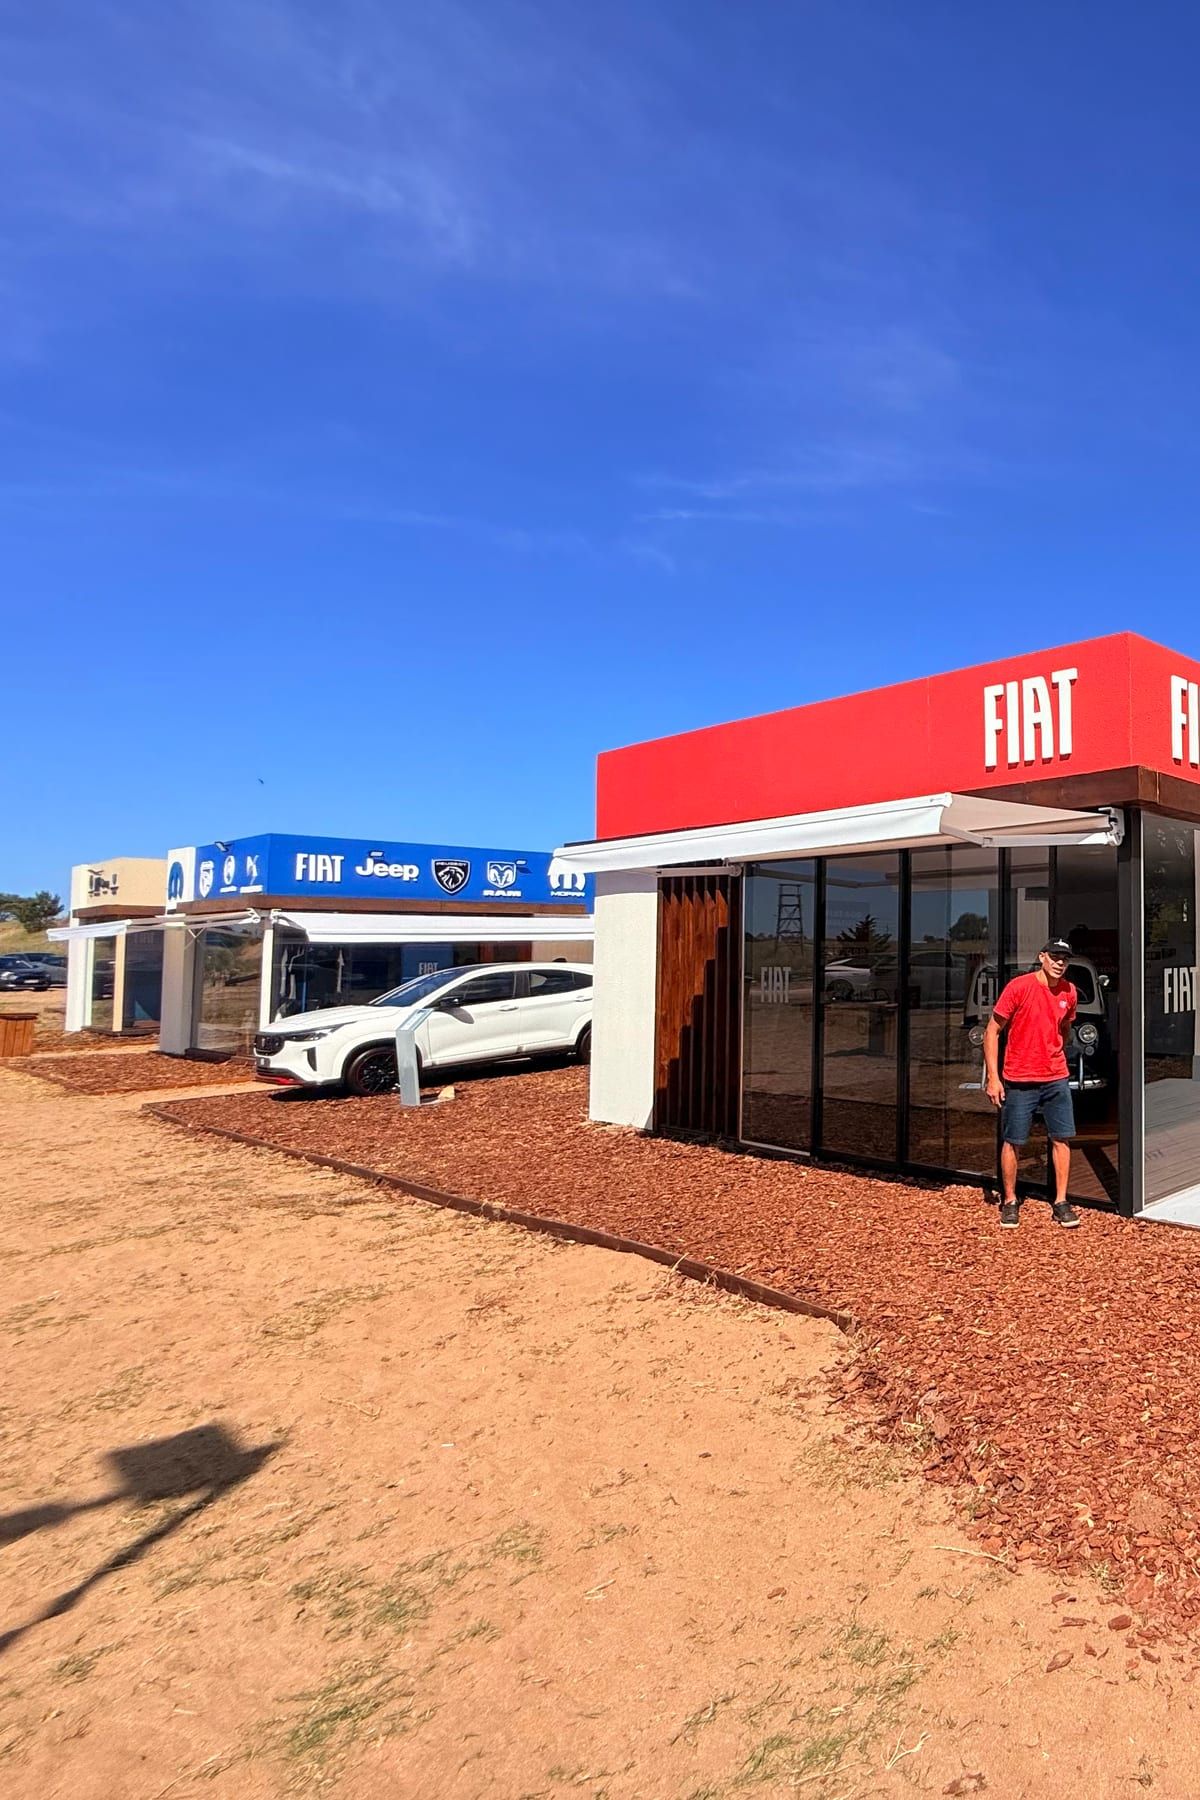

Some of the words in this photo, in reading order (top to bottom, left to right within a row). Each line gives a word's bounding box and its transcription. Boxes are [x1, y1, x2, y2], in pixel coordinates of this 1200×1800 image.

[984, 667, 1078, 767] FIAT
[296, 853, 344, 882] FIAT
[355, 858, 420, 881] Jeep
[761, 966, 792, 1003] FIAT
[1163, 966, 1200, 1014] FIAT
